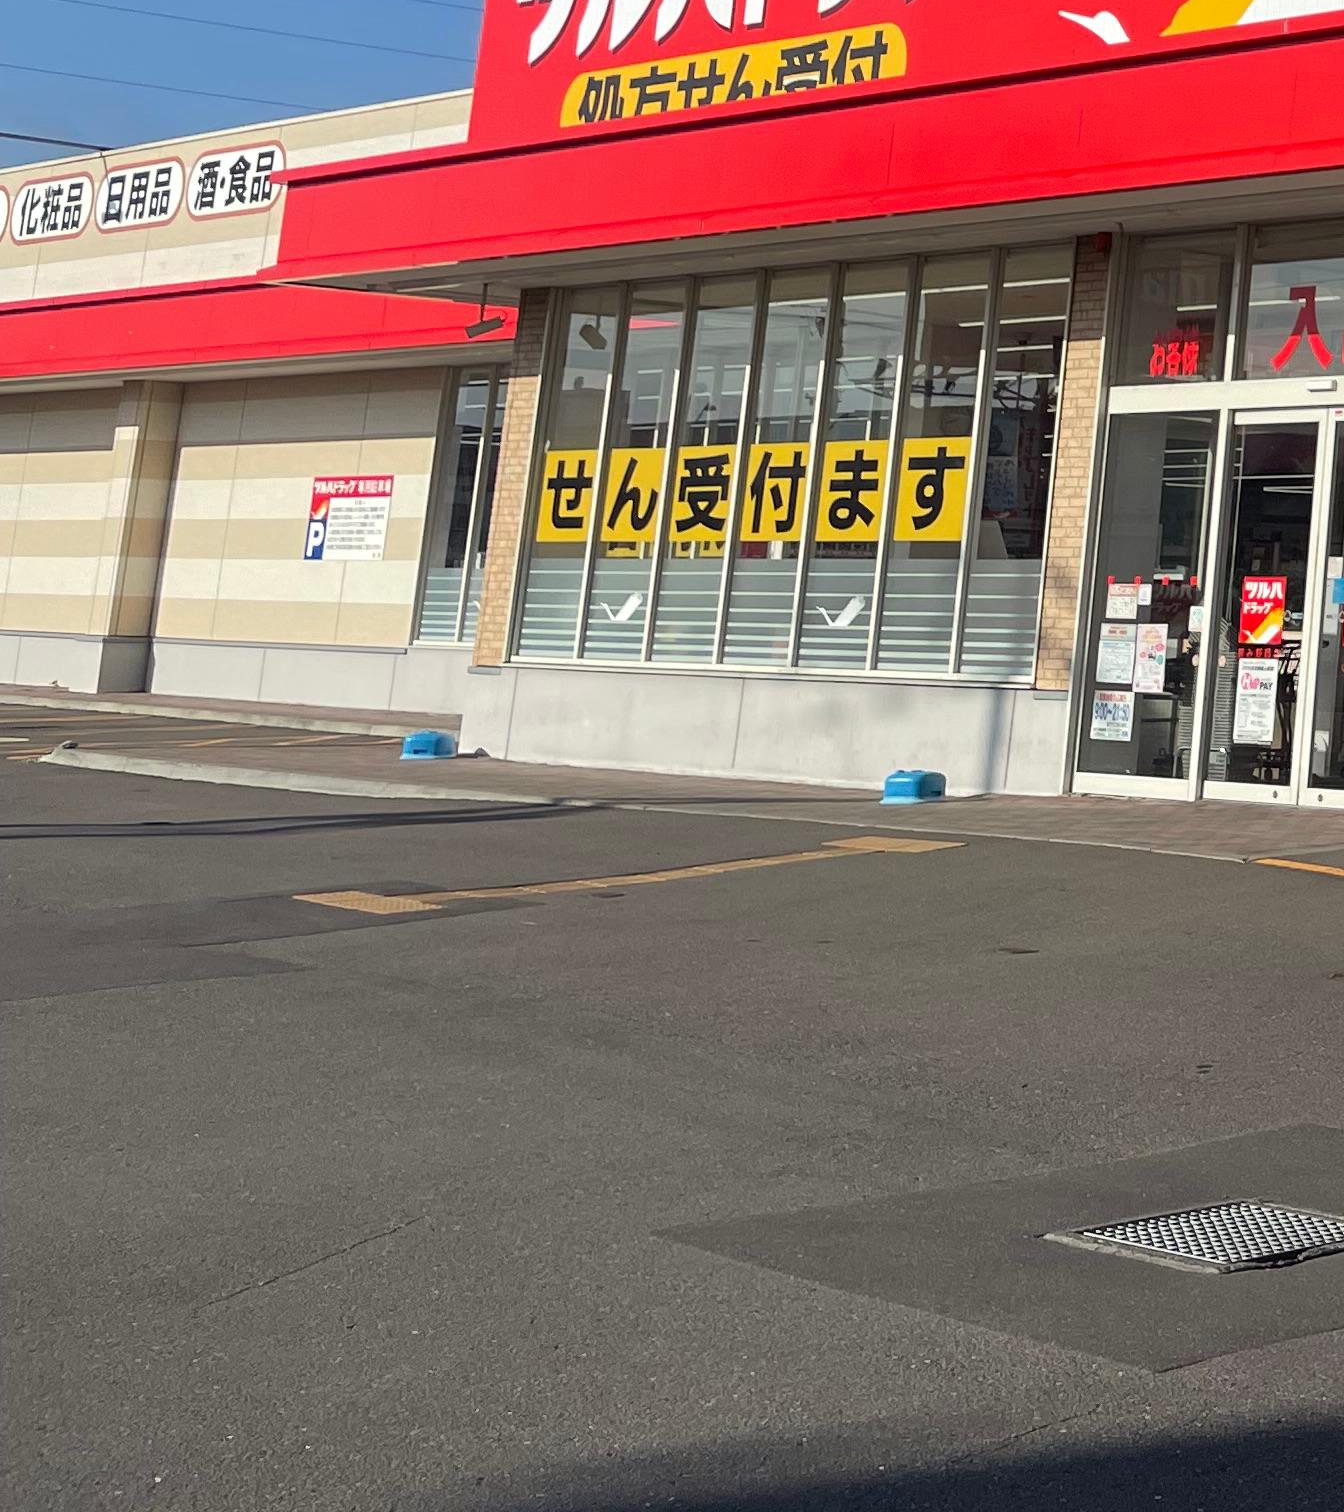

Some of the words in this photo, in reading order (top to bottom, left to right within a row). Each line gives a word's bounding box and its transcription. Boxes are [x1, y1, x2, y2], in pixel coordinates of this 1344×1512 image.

[102, 167, 173, 225] 日用品
[195, 150, 276, 210] 酒・食品
[19, 182, 84, 237] 化粧品
[546, 446, 966, 535] せん受付ます
[305, 521, 325, 557] P
[1242, 601, 1274, 615] ドラッグ
[1244, 581, 1284, 600] ツルハ
